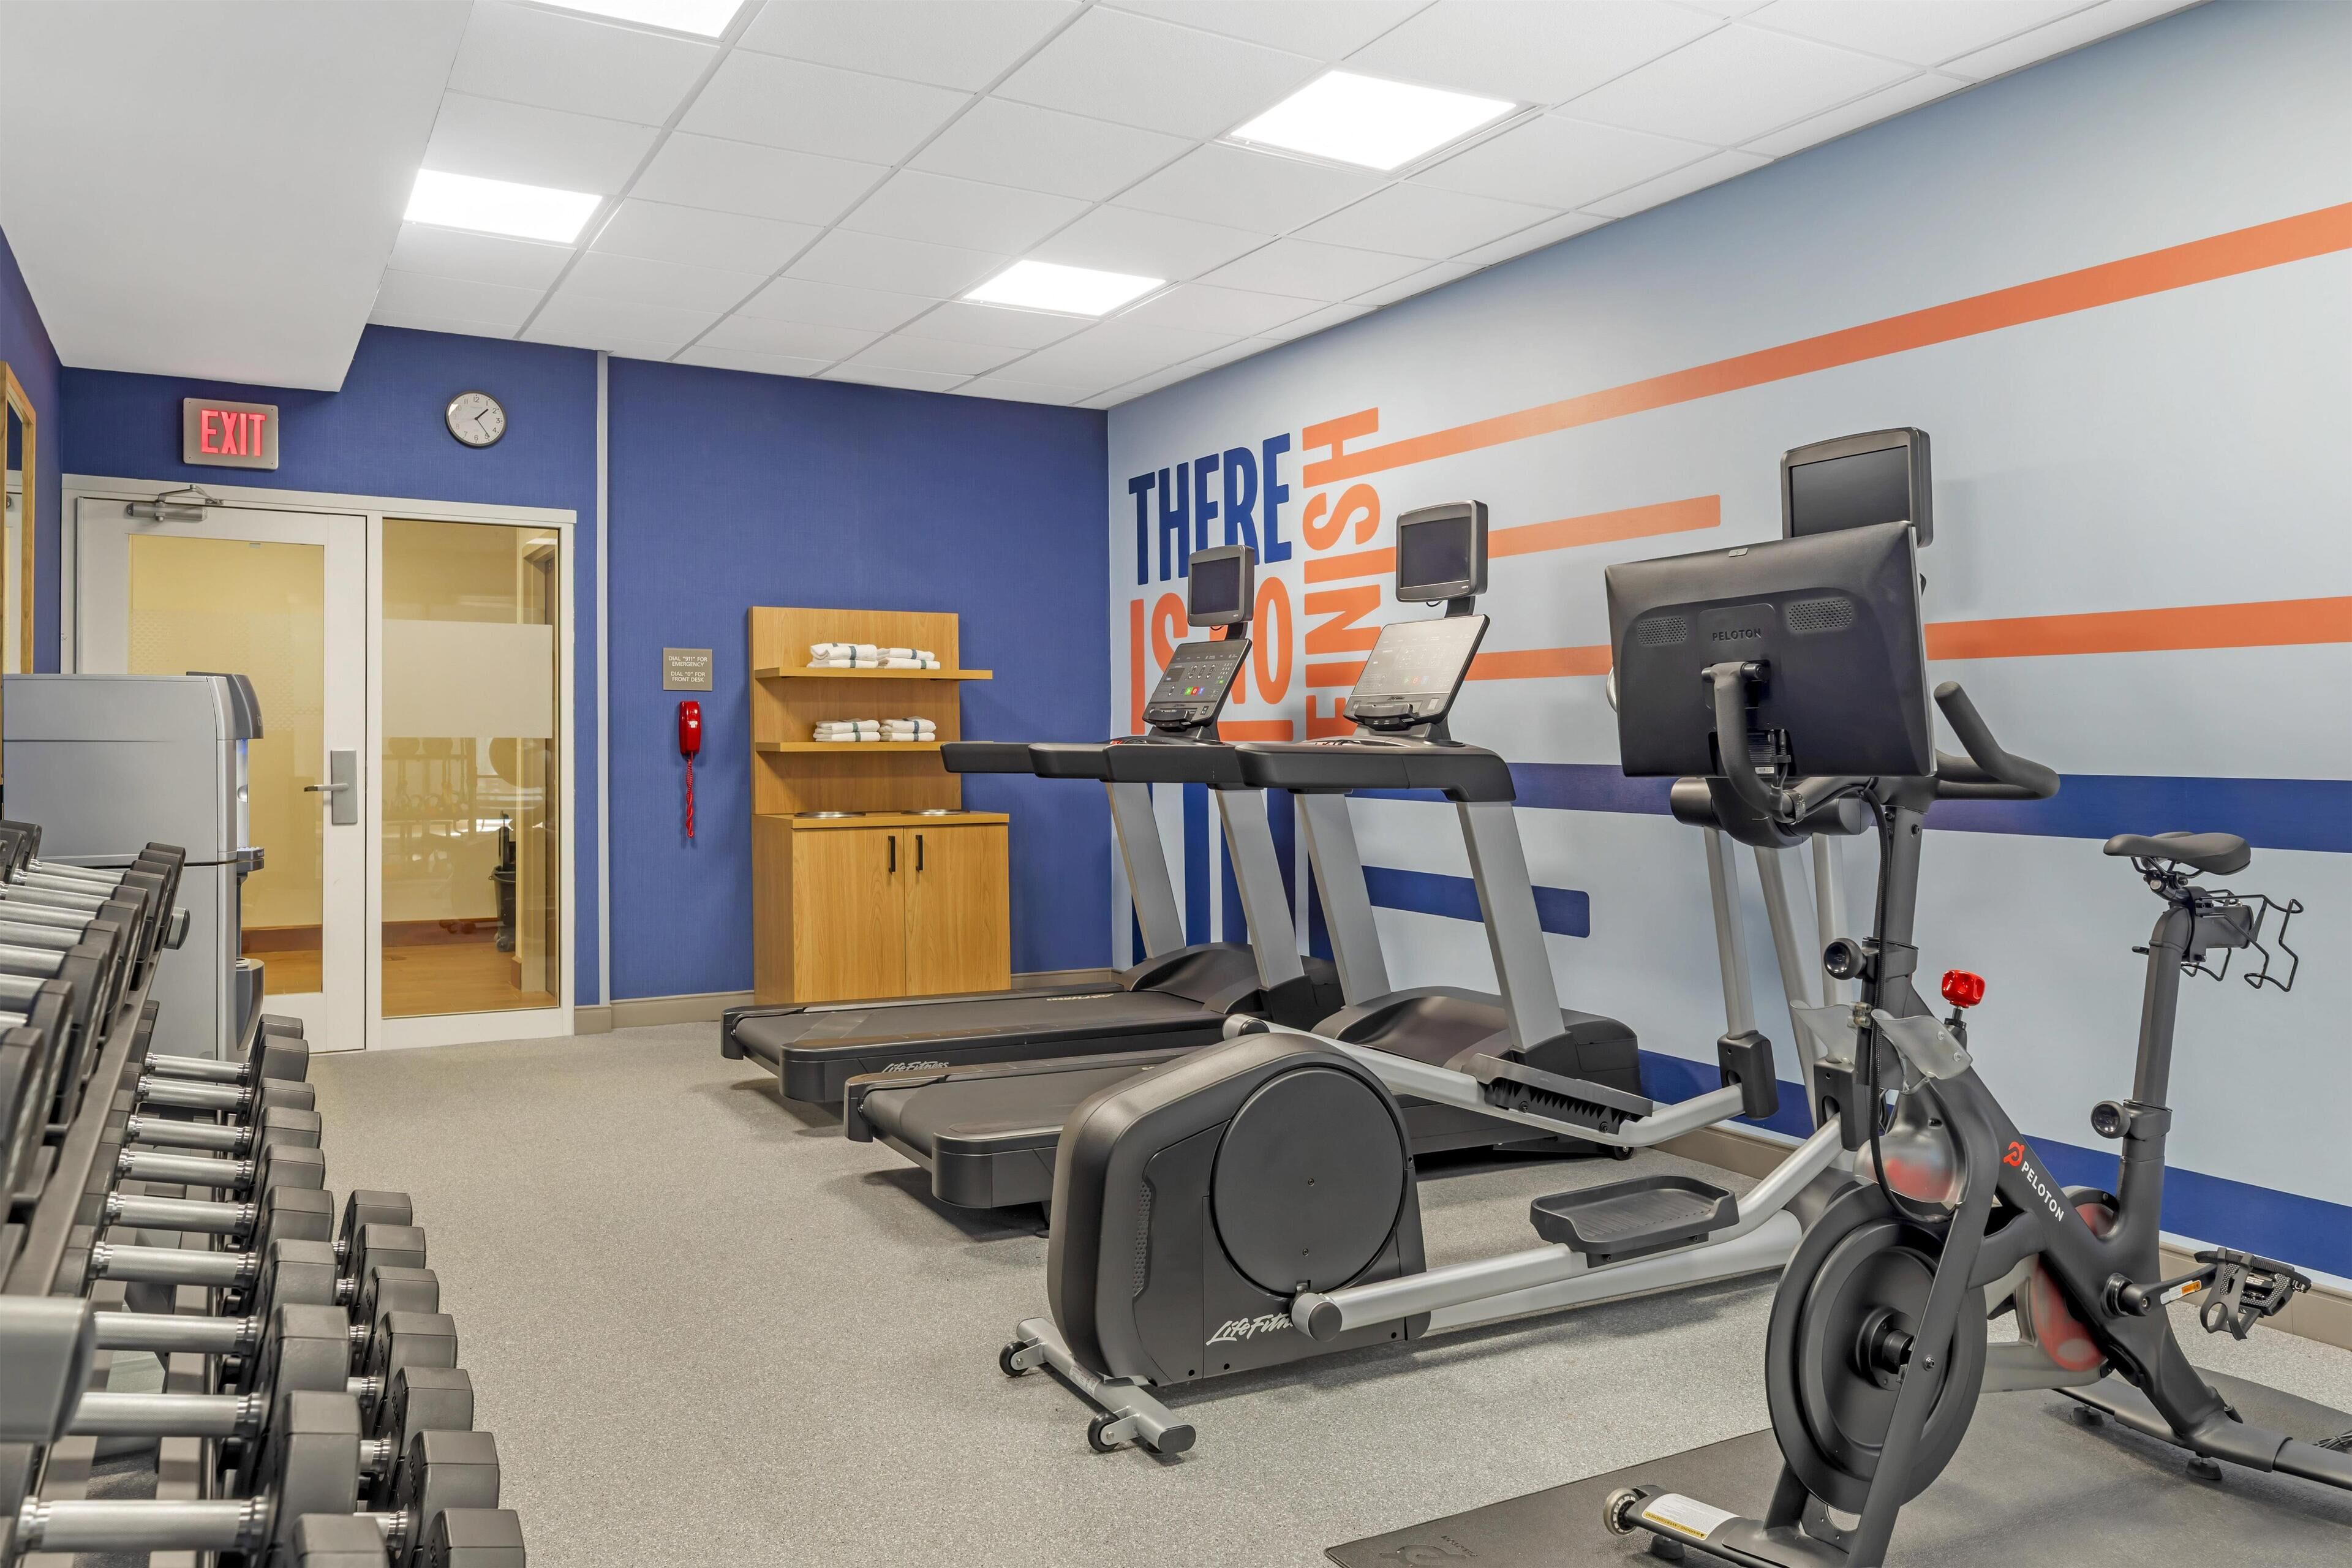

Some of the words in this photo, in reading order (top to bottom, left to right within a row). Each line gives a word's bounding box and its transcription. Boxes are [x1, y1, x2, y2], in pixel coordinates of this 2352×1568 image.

[201, 409, 266, 456] EXIT
[1128, 432, 1292, 586] THERE
[1302, 407, 1382, 741] FINISH
[1712, 627, 1762, 642] PELOTON
[2021, 1161, 2064, 1222] PELOTON
